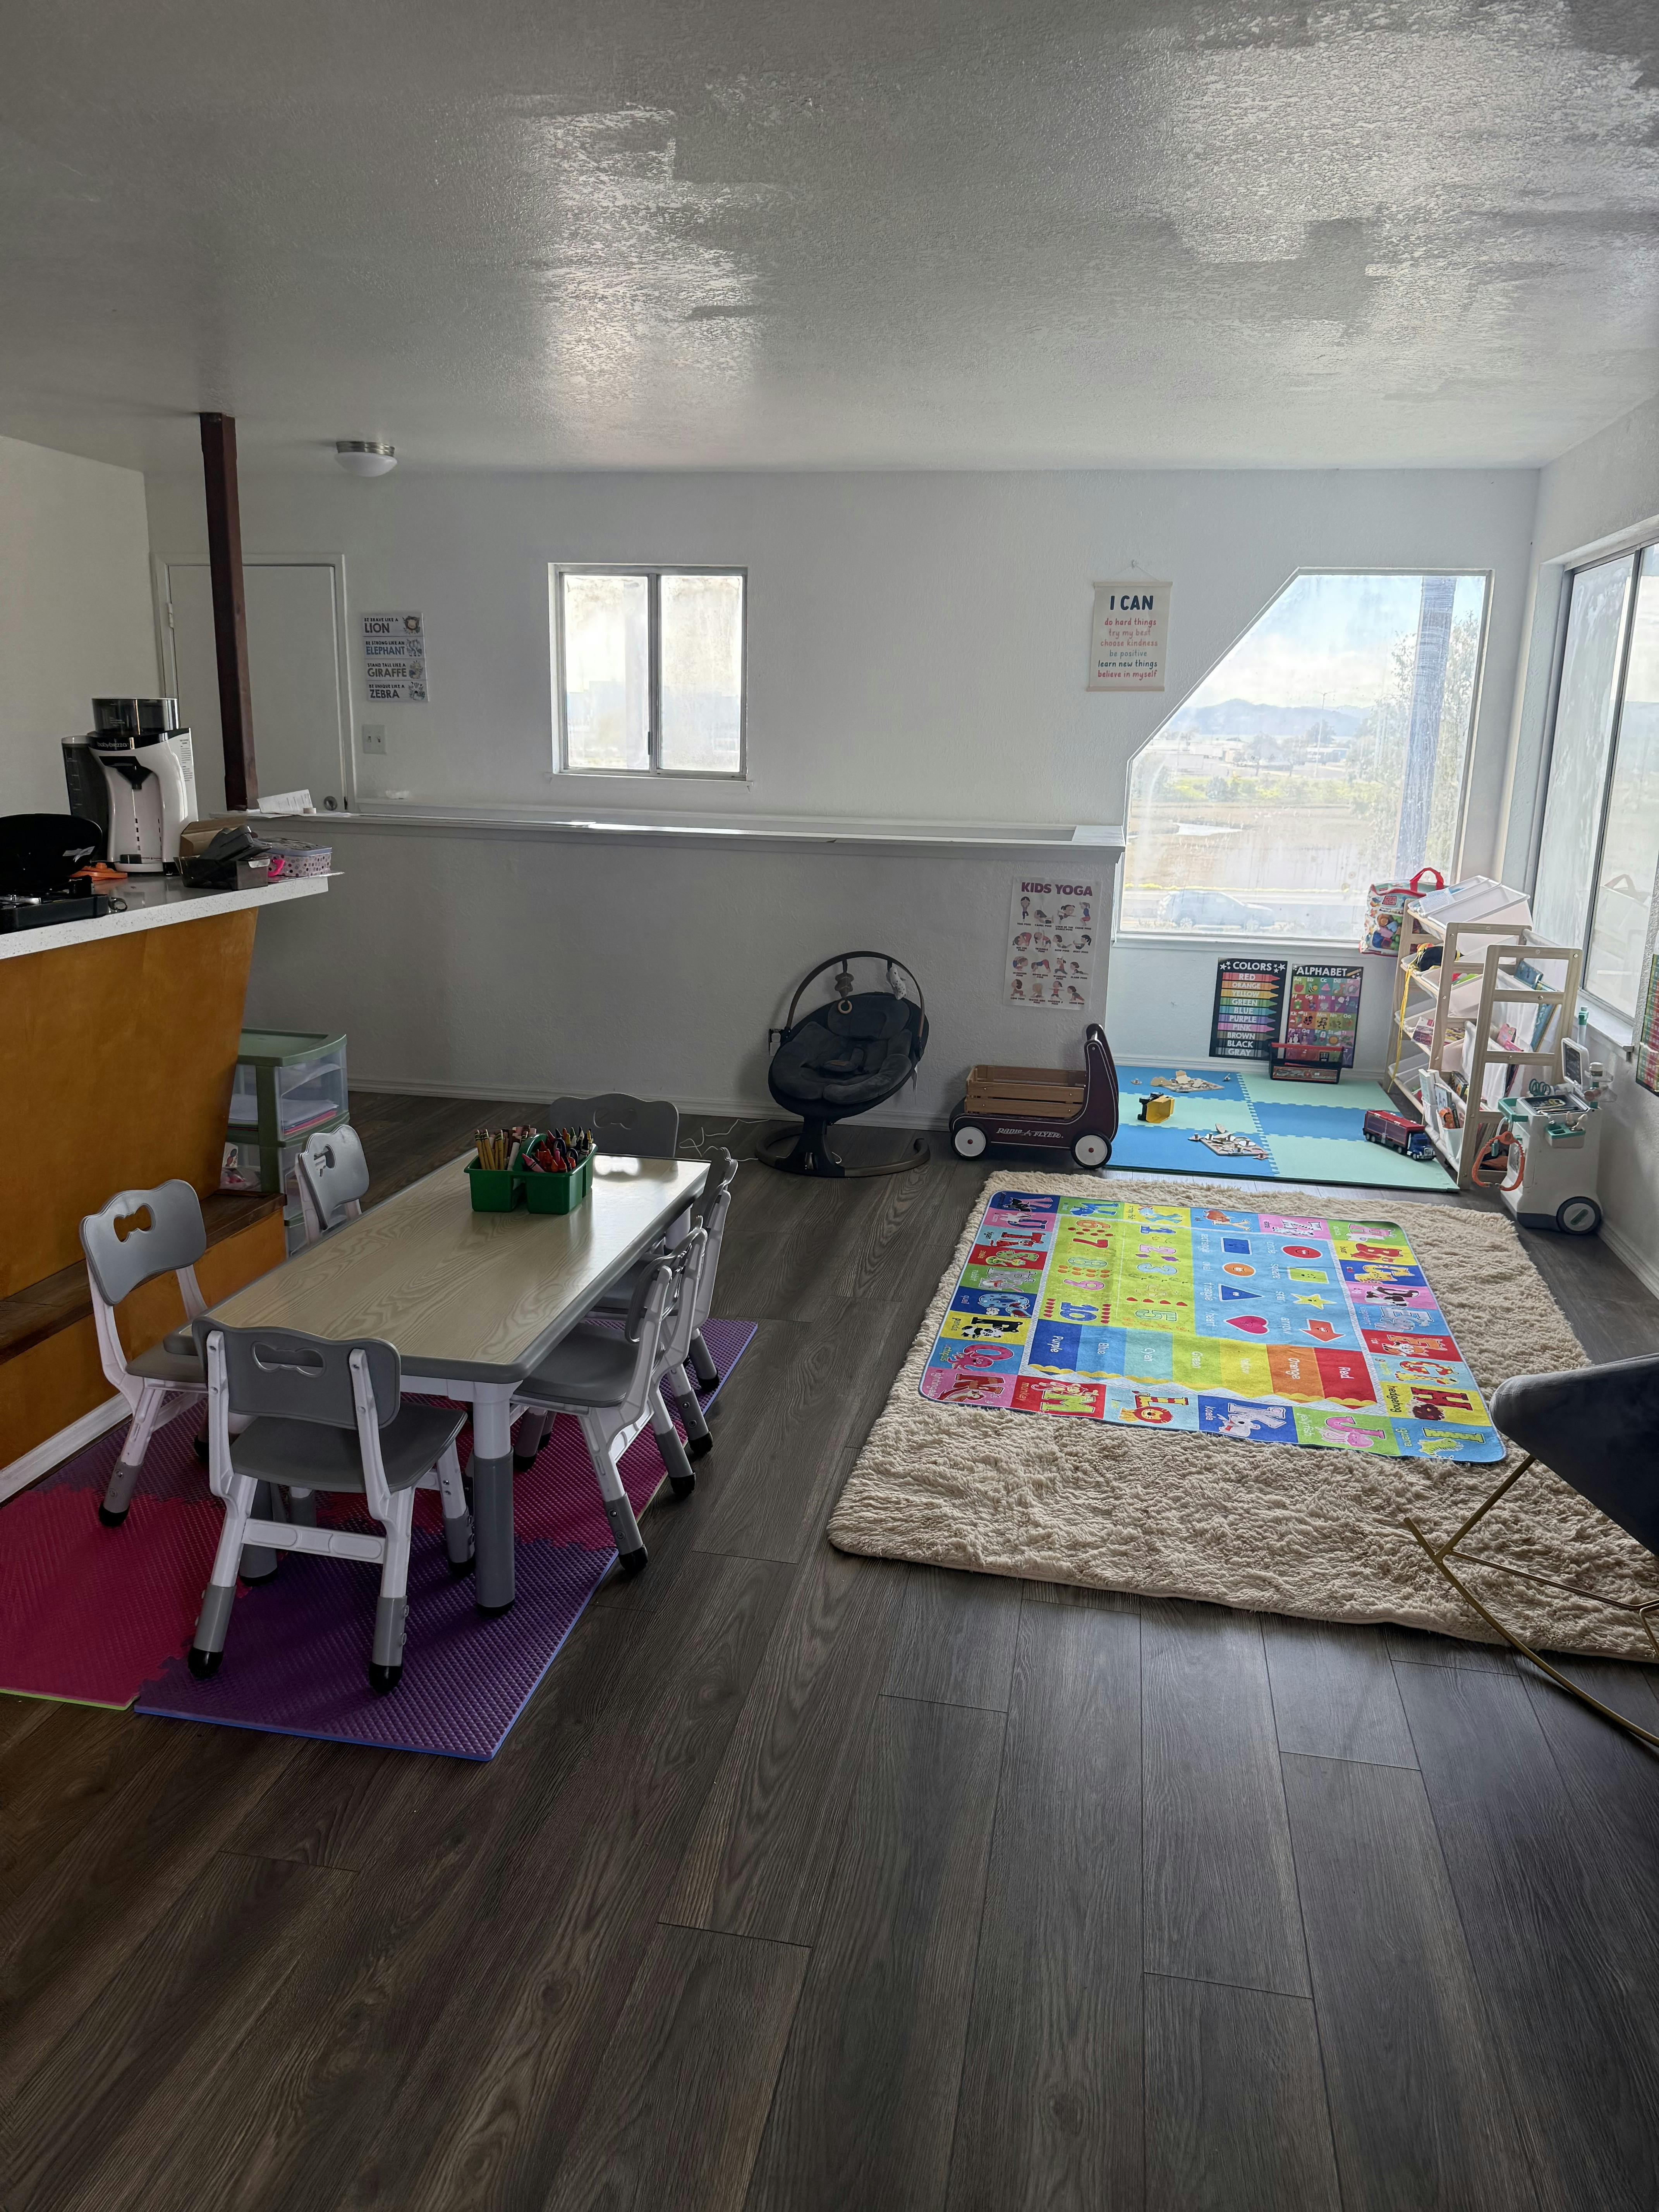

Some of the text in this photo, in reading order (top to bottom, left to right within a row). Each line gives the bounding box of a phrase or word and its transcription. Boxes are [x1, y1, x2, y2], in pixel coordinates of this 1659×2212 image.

[1110, 595, 1154, 610] I CAN
[364, 623, 390, 633] LION
[1134, 618, 1156, 628] things
[1109, 629, 1120, 639] try
[1122, 630, 1133, 639] my
[366, 646, 405, 655] ELEPHANT
[1120, 650, 1147, 659] positive
[1135, 660, 1158, 670] things
[368, 668, 407, 677] GIRAFFE
[1132, 670, 1158, 680] myself
[369, 689, 400, 698] ZEBRA
[1021, 882, 1093, 896] KIDS YOGA
[1233, 961, 1272, 971] COLORS
[1296, 966, 1347, 977] ALPHABET
[1076, 1220, 1111, 1229] 6
[1140, 1225, 1176, 1234] 1
[1001, 1232, 1046, 1244] T
[1073, 1238, 1108, 1248] 7
[996, 1250, 1039, 1262] S
[1139, 1244, 1176, 1254] 2
[1068, 1257, 1107, 1268] 8
[1137, 1262, 1178, 1275] 3
[988, 1267, 1037, 1284] R
[1064, 1279, 1104, 1291] 9
[1200, 1282, 1215, 1301] triangle
[1276, 1291, 1286, 1302] star
[1060, 1302, 1099, 1322] 10
[1135, 1309, 1177, 1322] 5
[951, 1317, 961, 1331] panda
[971, 1317, 1024, 1333] P
[1206, 1313, 1218, 1327] heart
[1281, 1317, 1291, 1334] arrow
[1050, 1335, 1063, 1353] Purple
[1097, 1342, 1109, 1355] Blue
[1387, 1334, 1448, 1351] F
[964, 1344, 1014, 1361] O
[1140, 1348, 1156, 1362] Cyan
[1192, 1351, 1203, 1369] Green
[1285, 1357, 1300, 1379] Orange
[1338, 1367, 1355, 1379] Red
[1399, 1360, 1459, 1376] G
[928, 1369, 943, 1396] nightingale
[953, 1373, 1005, 1395] N
[1019, 1382, 1029, 1401] monkey
[1410, 1386, 1473, 1411] H
[1040, 1389, 1096, 1413] M
[1135, 1394, 1189, 1409] L
[1386, 1385, 1403, 1413] hedgehog
[1205, 1406, 1216, 1420] koala
[1228, 1402, 1286, 1429] K
[1297, 1413, 1316, 1436] jellyfish
[1326, 1415, 1386, 1439] J
[1395, 1427, 1412, 1447] iguana
[1422, 1427, 1486, 1444] I
